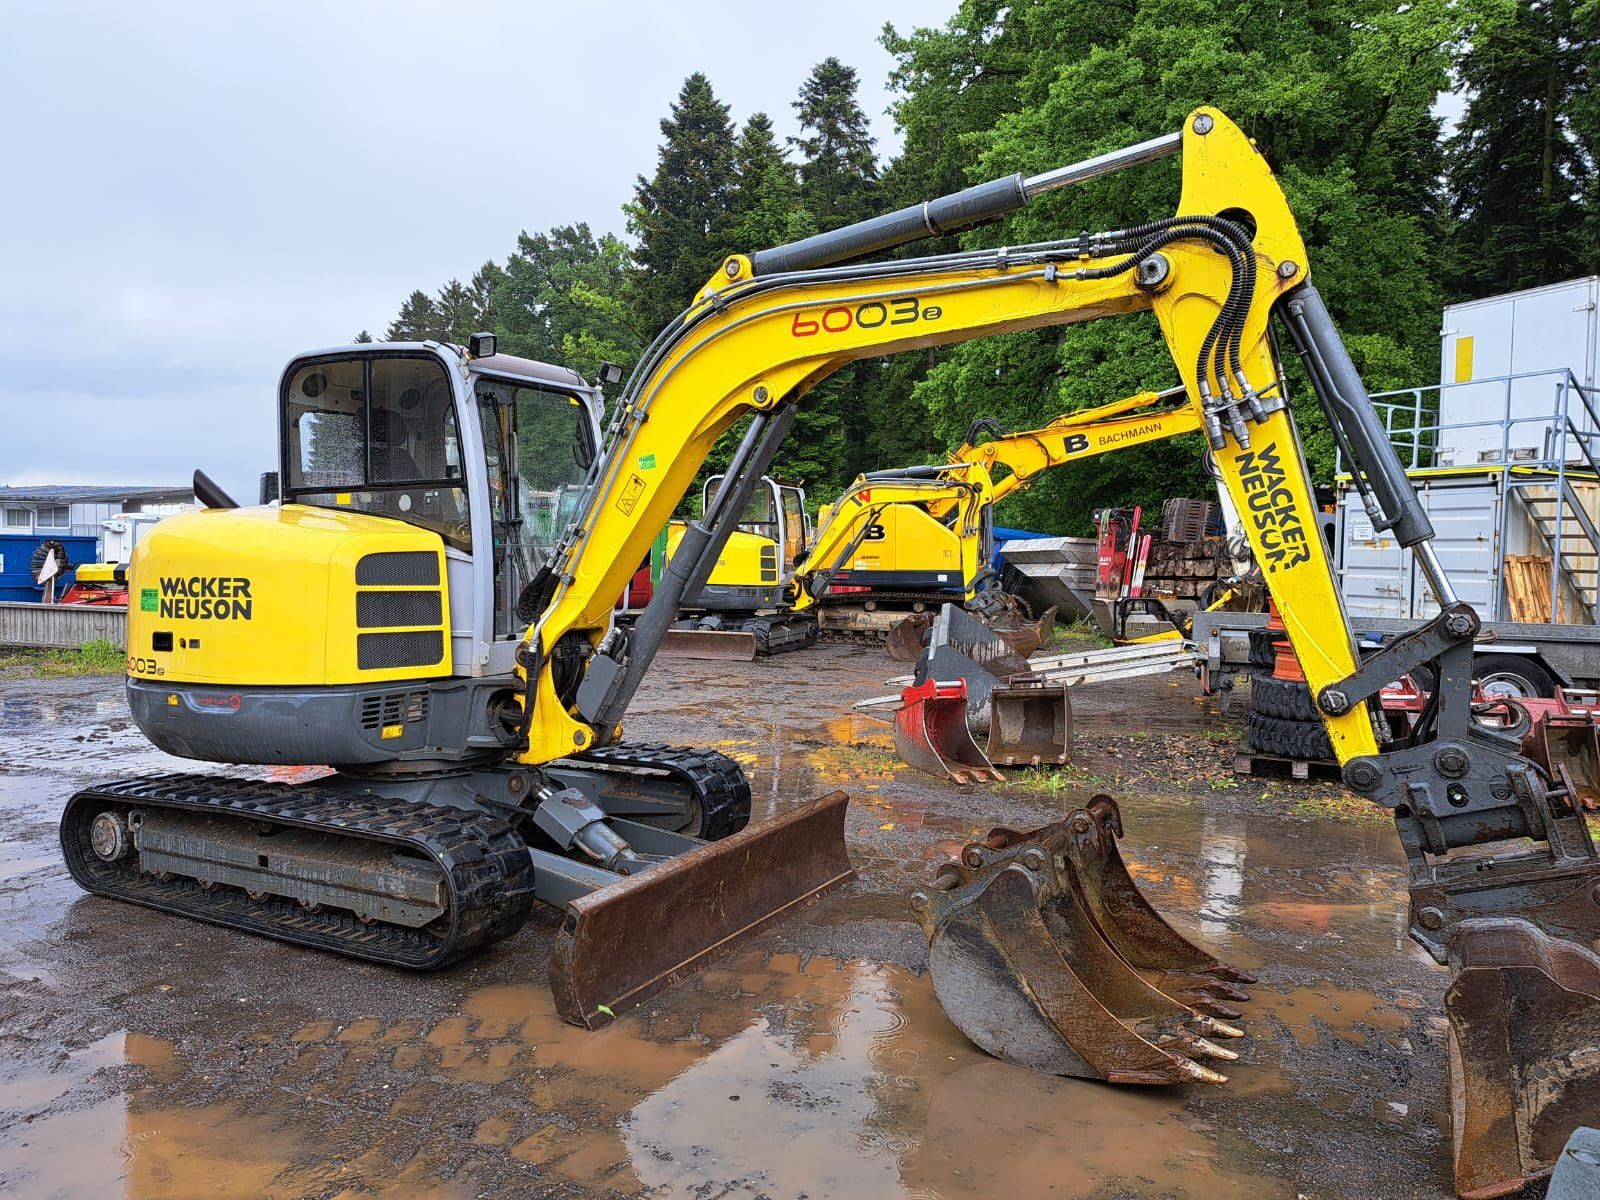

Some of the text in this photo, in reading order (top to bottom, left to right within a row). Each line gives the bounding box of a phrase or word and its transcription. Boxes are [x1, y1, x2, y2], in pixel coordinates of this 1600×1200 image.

[1063, 422, 1162, 454] B BACHMANN
[1234, 452, 1287, 573] NEUSON
[1257, 441, 1311, 571] WACKER
[159, 576, 252, 598] WACKER
[160, 597, 252, 620] NEUSON
